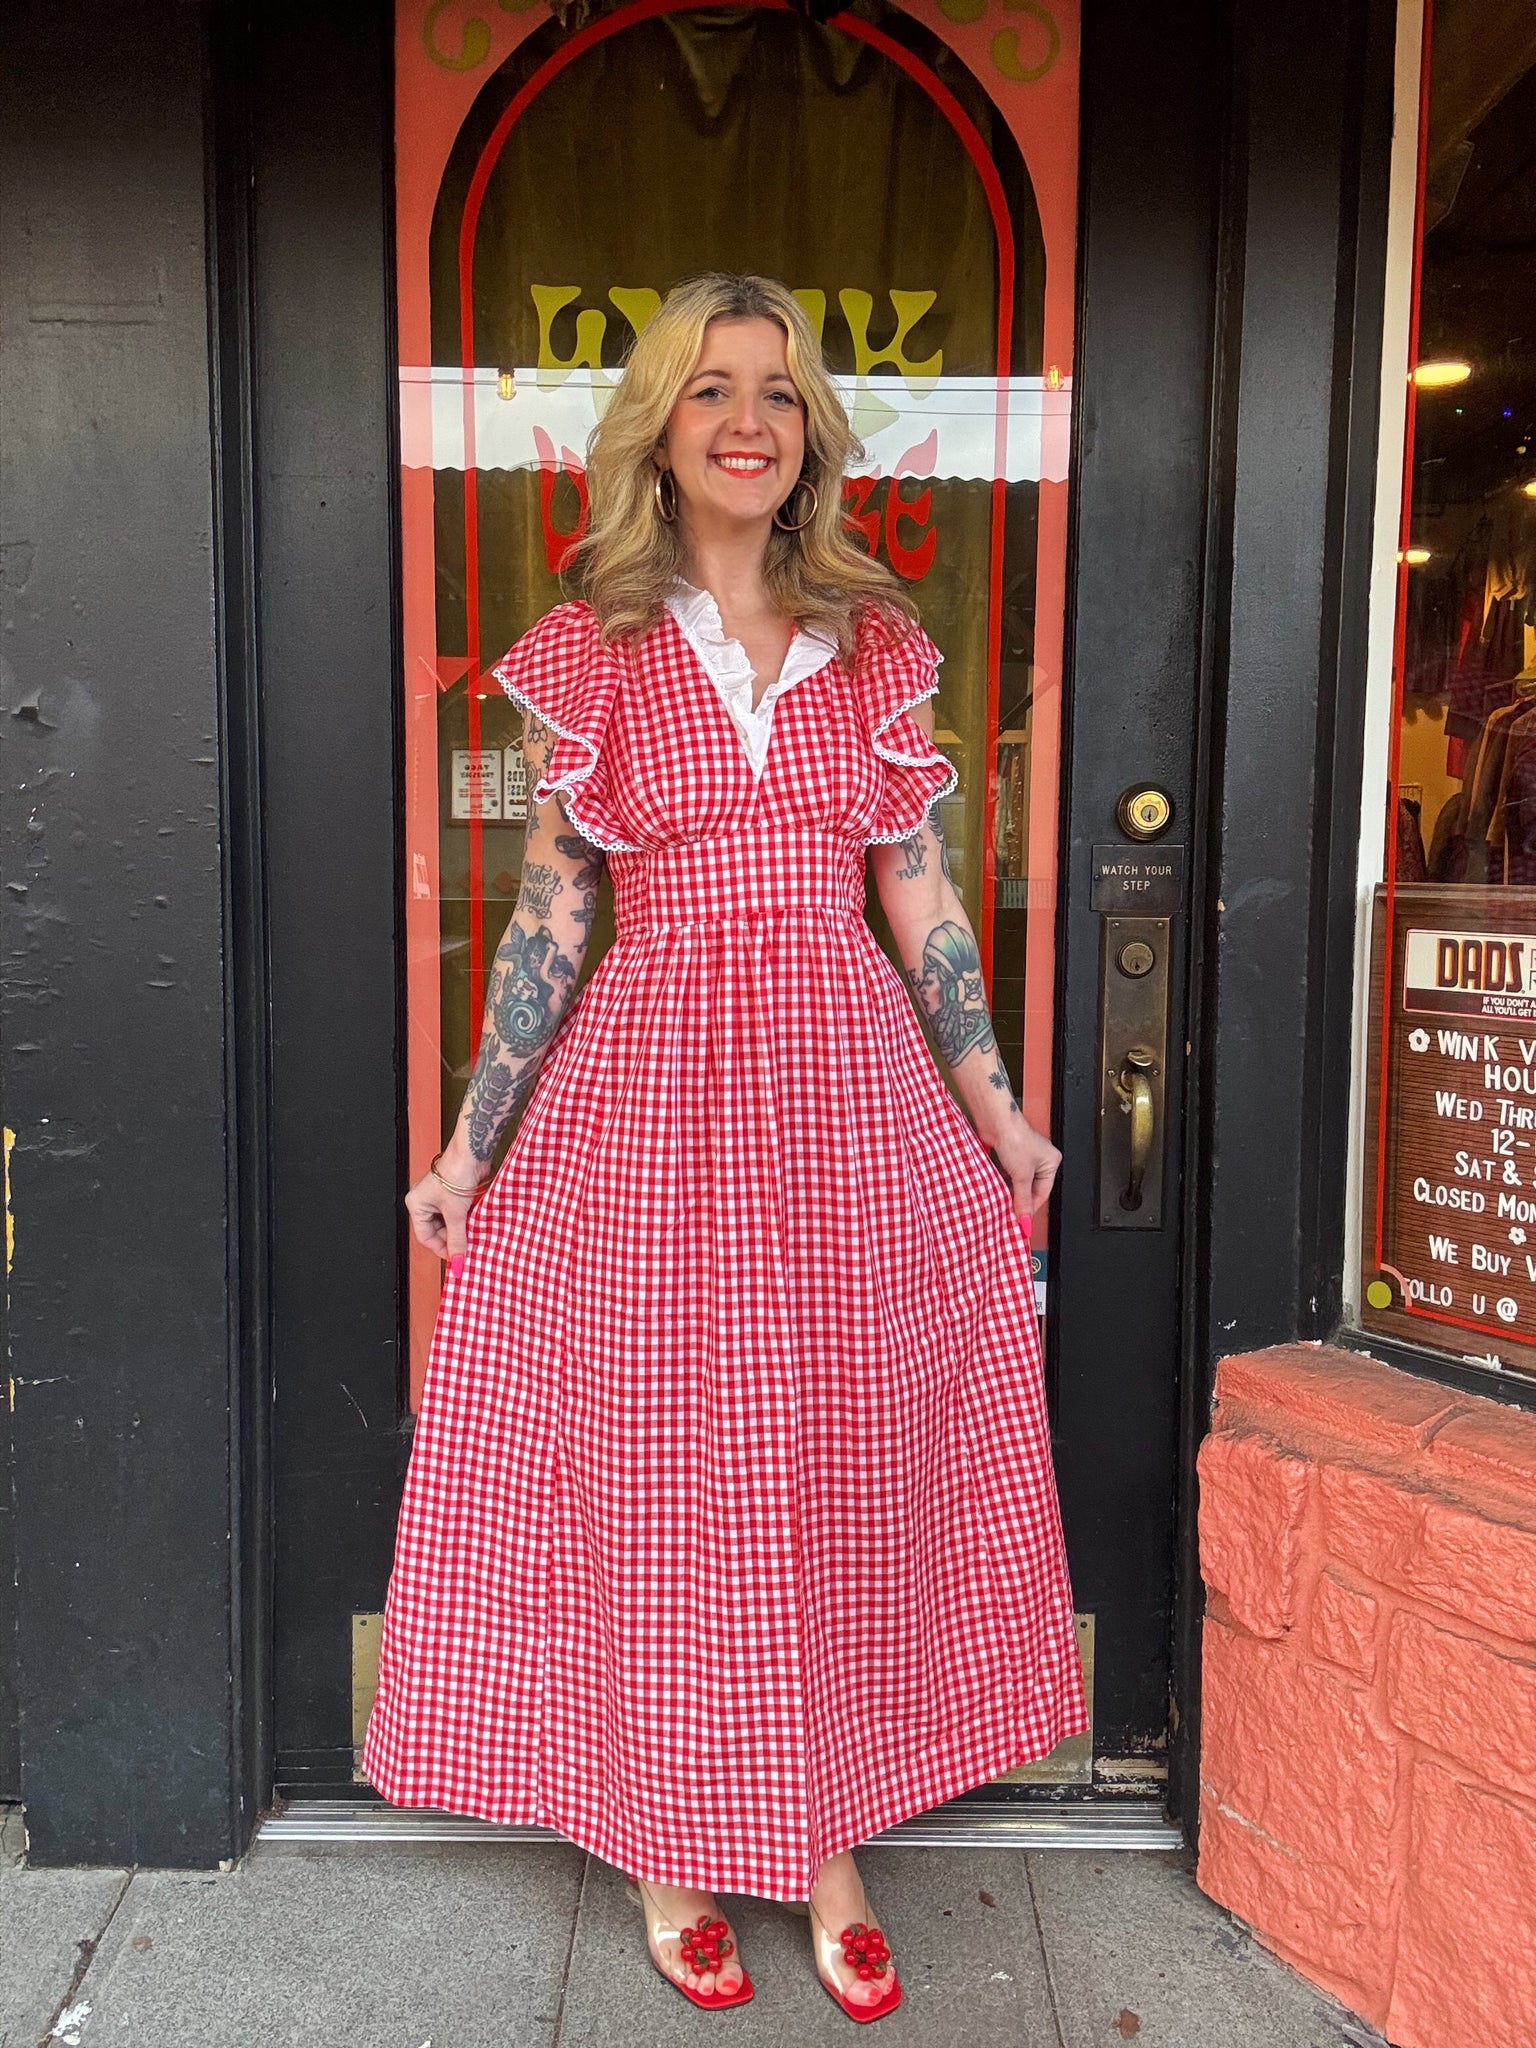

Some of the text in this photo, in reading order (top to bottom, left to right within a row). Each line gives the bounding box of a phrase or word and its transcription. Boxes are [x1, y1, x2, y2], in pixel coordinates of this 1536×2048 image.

[1102, 865, 1172, 876] WATCH YOUR
[1123, 880, 1151, 891] STEP
[1435, 938, 1524, 993] DADS
[1481, 1005, 1494, 1014] ALL
[1494, 1006, 1517, 1016] YOU'LL
[1517, 1008, 1532, 1017] GET
[1482, 996, 1490, 1005] IF
[1490, 997, 1506, 1006] YOU
[1506, 998, 1530, 1008] DON'T
[1437, 1030, 1500, 1062] WINK
[1435, 1090, 1536, 1130] WED THR
[1491, 1128, 1536, 1156] 12-
[1453, 1150, 1497, 1181] SAT
[1502, 1159, 1523, 1186] &
[1413, 1177, 1486, 1213] CLOSED
[1428, 1234, 1459, 1265] WE
[1471, 1243, 1512, 1276] BUY
[1472, 1293, 1486, 1315] U
[1496, 1297, 1518, 1323] @
